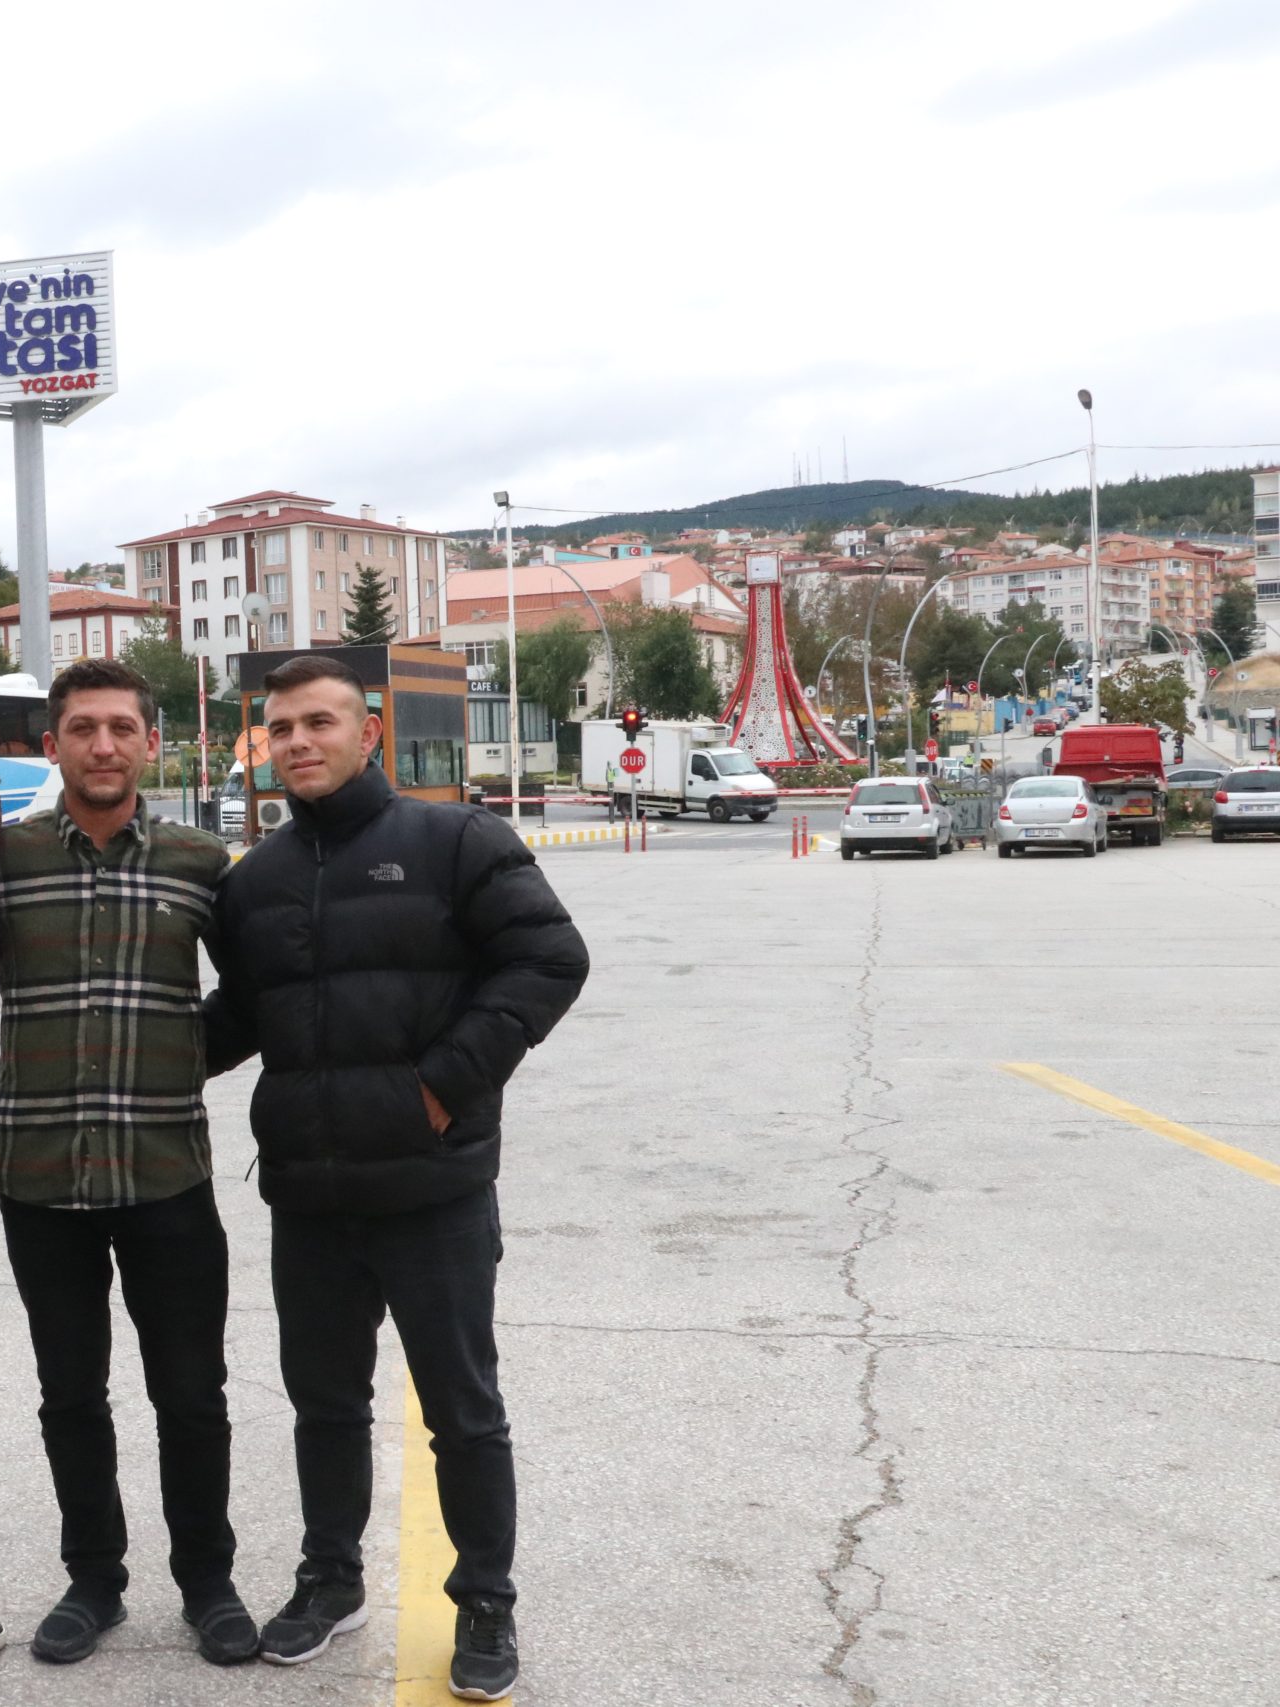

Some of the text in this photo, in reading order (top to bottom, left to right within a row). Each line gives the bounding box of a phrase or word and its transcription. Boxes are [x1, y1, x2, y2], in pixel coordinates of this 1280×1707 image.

[5, 303, 97, 338] tam
[20, 373, 98, 394] YOZGAT
[471, 681, 492, 692] CAFE
[621, 755, 644, 766] DUR
